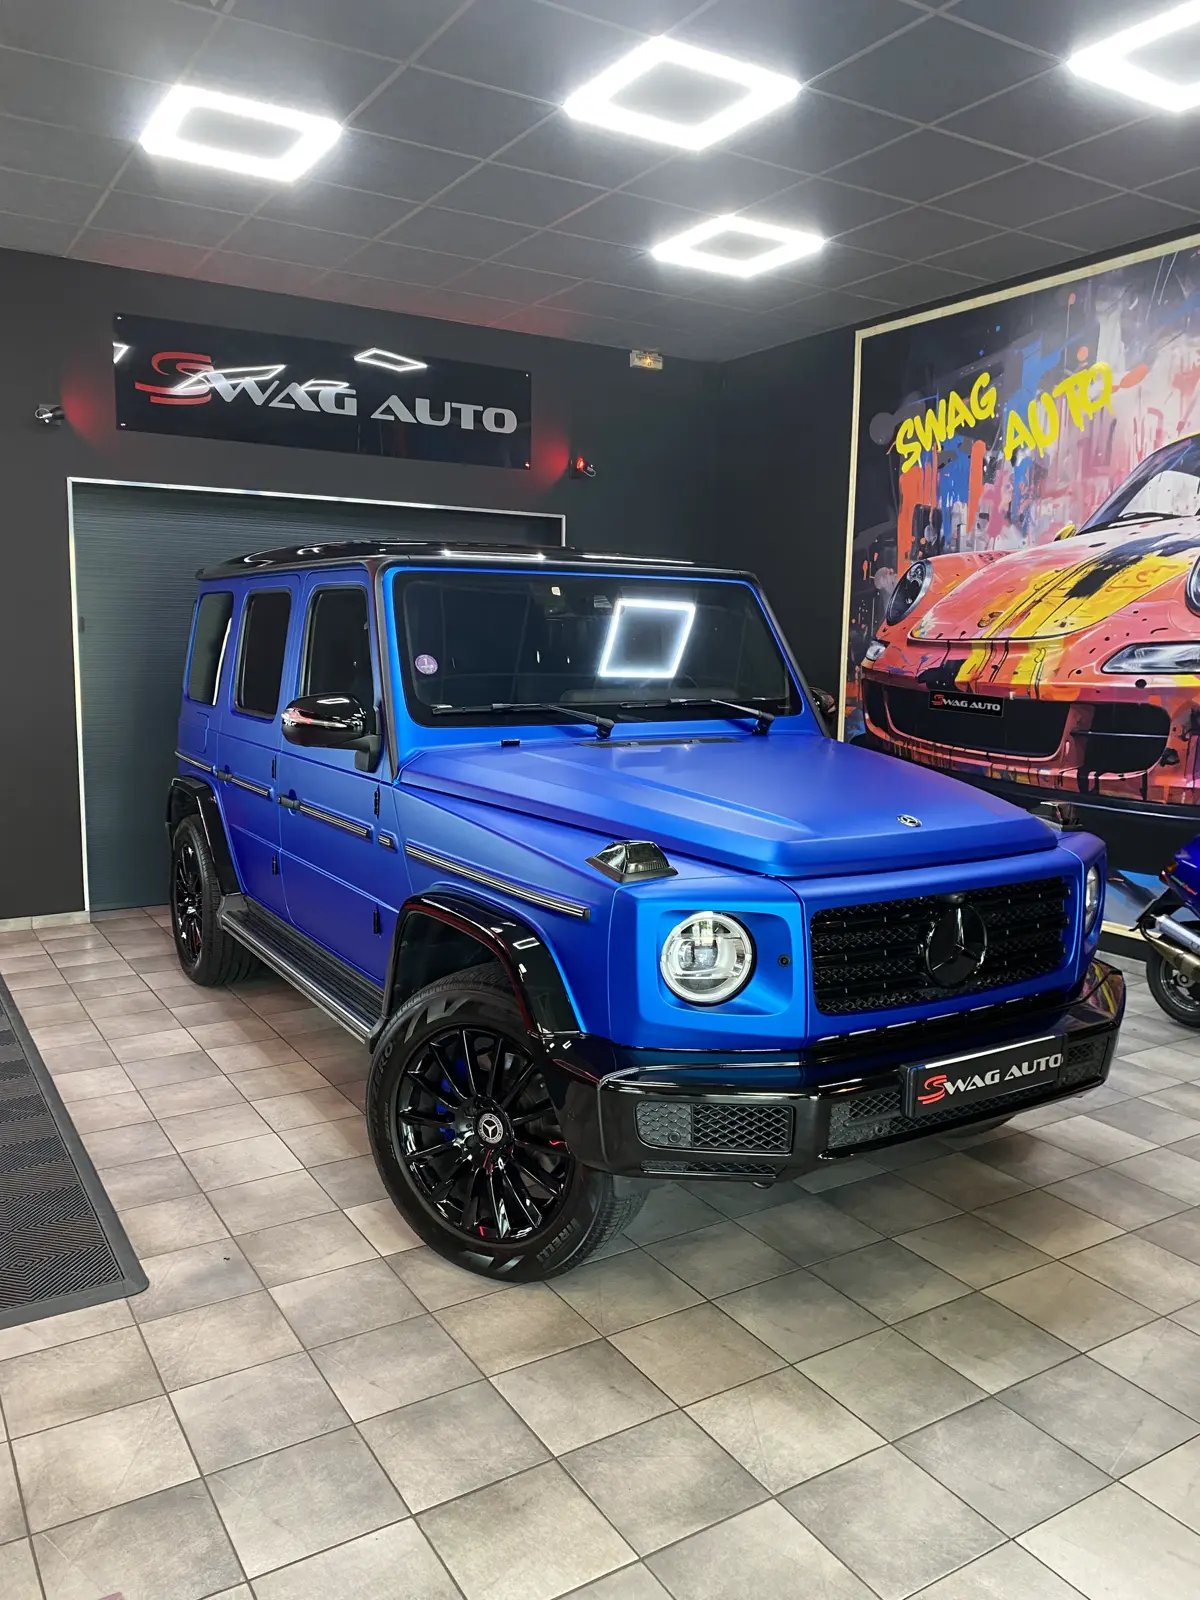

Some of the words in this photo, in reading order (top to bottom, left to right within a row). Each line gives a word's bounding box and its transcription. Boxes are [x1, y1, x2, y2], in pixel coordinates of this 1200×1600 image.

[134, 350, 358, 417] SWAG
[370, 394, 518, 435] AUTO
[895, 371, 998, 473] SWAG
[1003, 361, 1114, 461] AUTO
[931, 694, 968, 707] SWAG
[969, 702, 1001, 711] AUTO
[917, 1069, 1001, 1105] SWAG
[1004, 1053, 1063, 1081] AUTO
